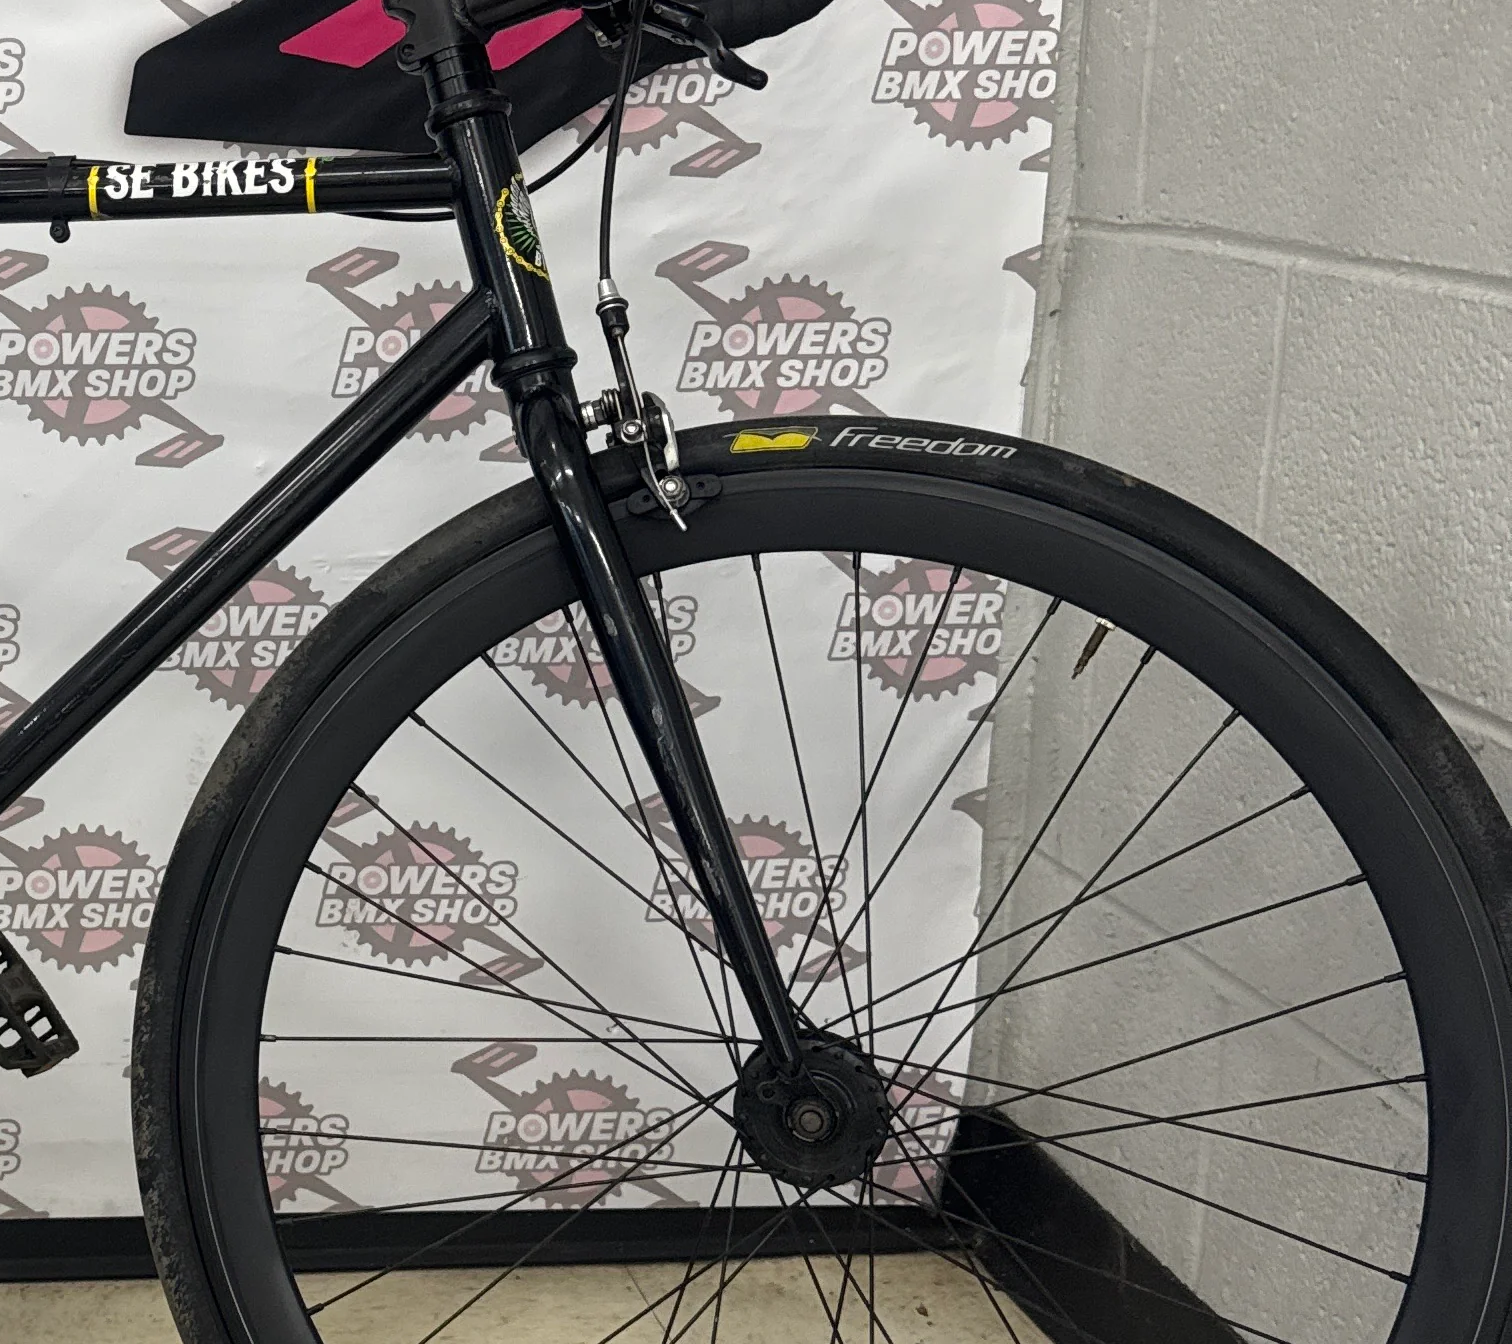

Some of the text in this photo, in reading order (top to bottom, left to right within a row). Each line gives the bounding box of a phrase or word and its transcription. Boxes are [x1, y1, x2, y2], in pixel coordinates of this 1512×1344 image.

[886, 32, 1058, 65] POWER
[627, 75, 735, 104] SHOP
[879, 70, 1056, 99] BMX SHO
[105, 158, 296, 199] SE BIKES
[690, 322, 887, 356] POWERS
[85, 369, 191, 397] SHOP
[681, 359, 884, 388] BMX SHOP
[829, 426, 1018, 459] freedom
[198, 606, 328, 637] OWER
[842, 595, 1003, 623] POWER
[494, 637, 576, 663] BMX
[838, 631, 1001, 656] BMX SHO
[331, 865, 514, 895] POWERS
[81, 903, 154, 929] SHO
[320, 898, 514, 924] BMX SHOP
[651, 893, 709, 920] BM
[262, 1117, 346, 1146] ERS
[490, 1114, 673, 1142] POWERS
[267, 1150, 346, 1173] HOP
[485, 1146, 674, 1171] BMX SHOP
